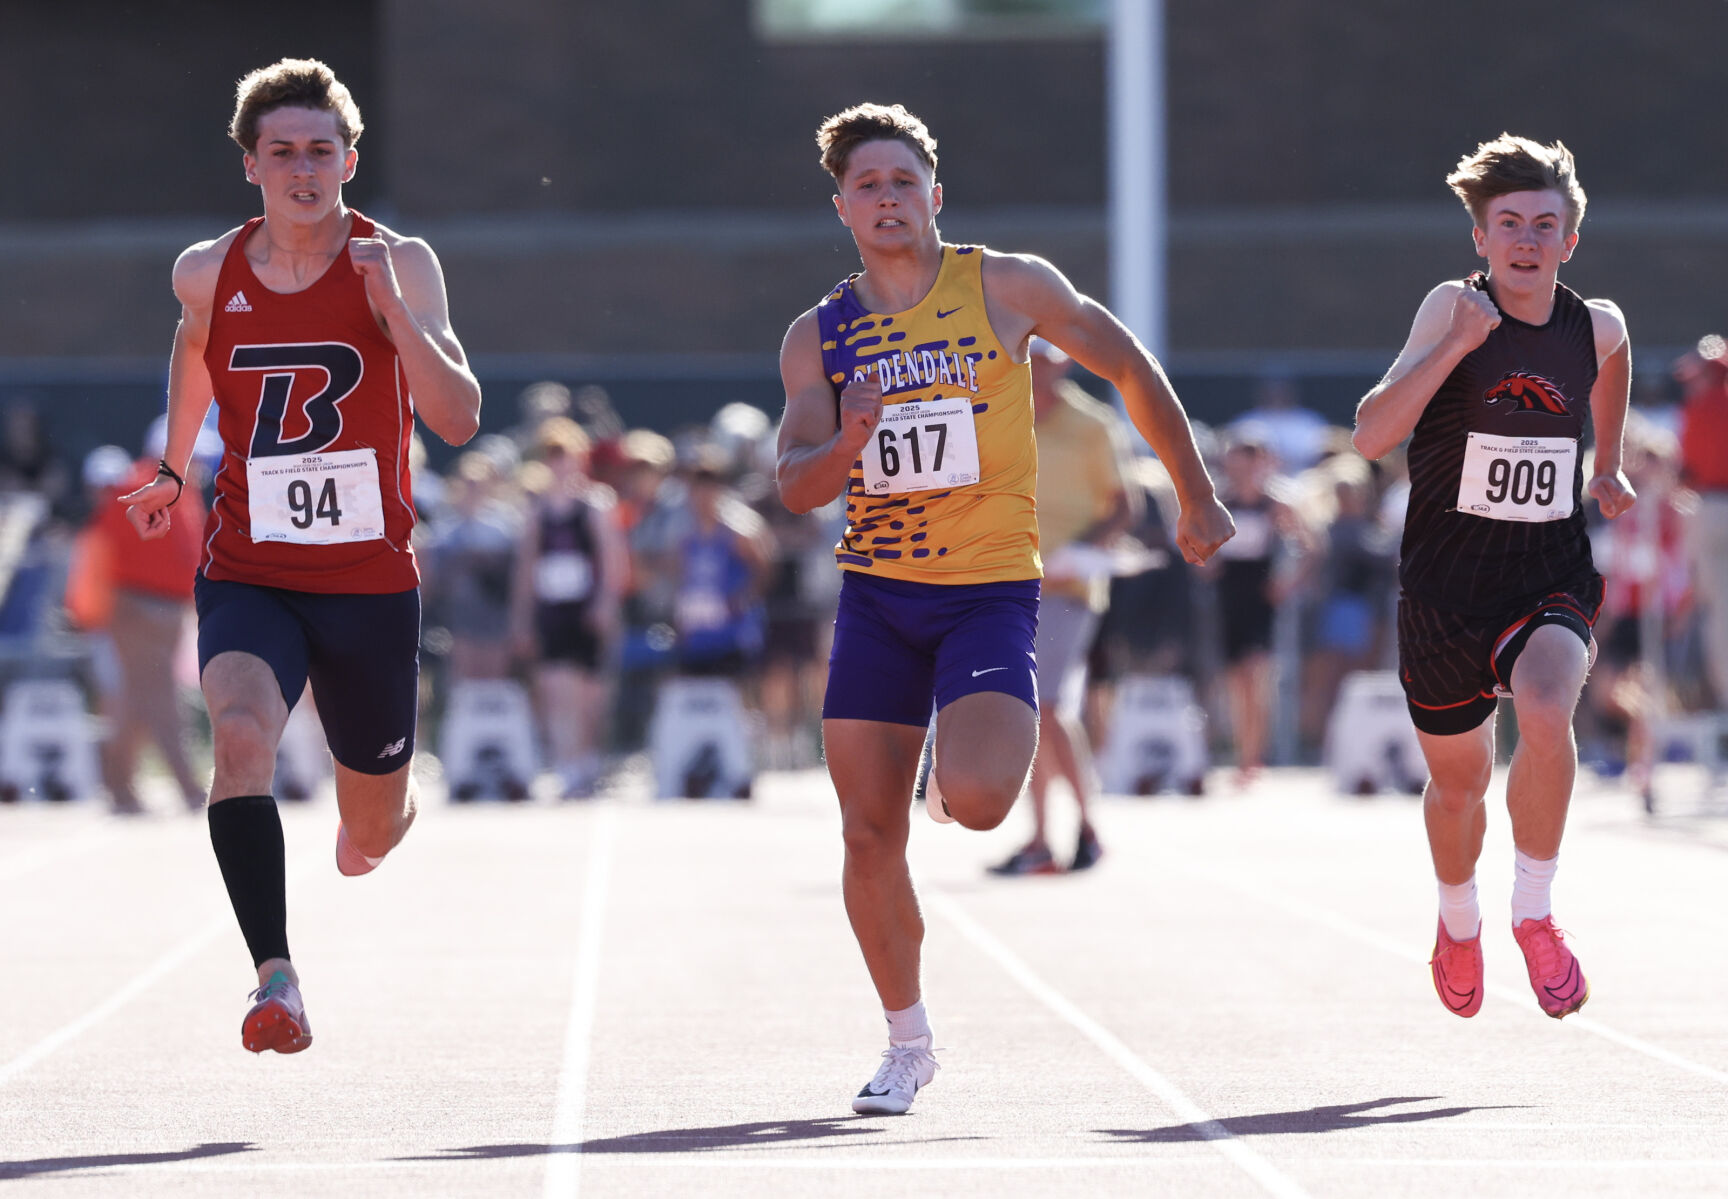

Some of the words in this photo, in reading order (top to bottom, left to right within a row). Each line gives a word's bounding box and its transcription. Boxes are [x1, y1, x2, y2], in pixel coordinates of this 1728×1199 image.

[225, 304, 252, 312] adidas
[848, 350, 978, 393] DENDALE
[228, 341, 364, 458] B
[900, 404, 920, 412] 2025
[917, 409, 964, 419] CHAMPIONSHIPS
[285, 467, 301, 475] FIELD
[319, 461, 368, 472] CHAMPIONSHIPS
[878, 423, 948, 477] 617
[287, 477, 342, 530] 94
[1485, 458, 1556, 506] 909
